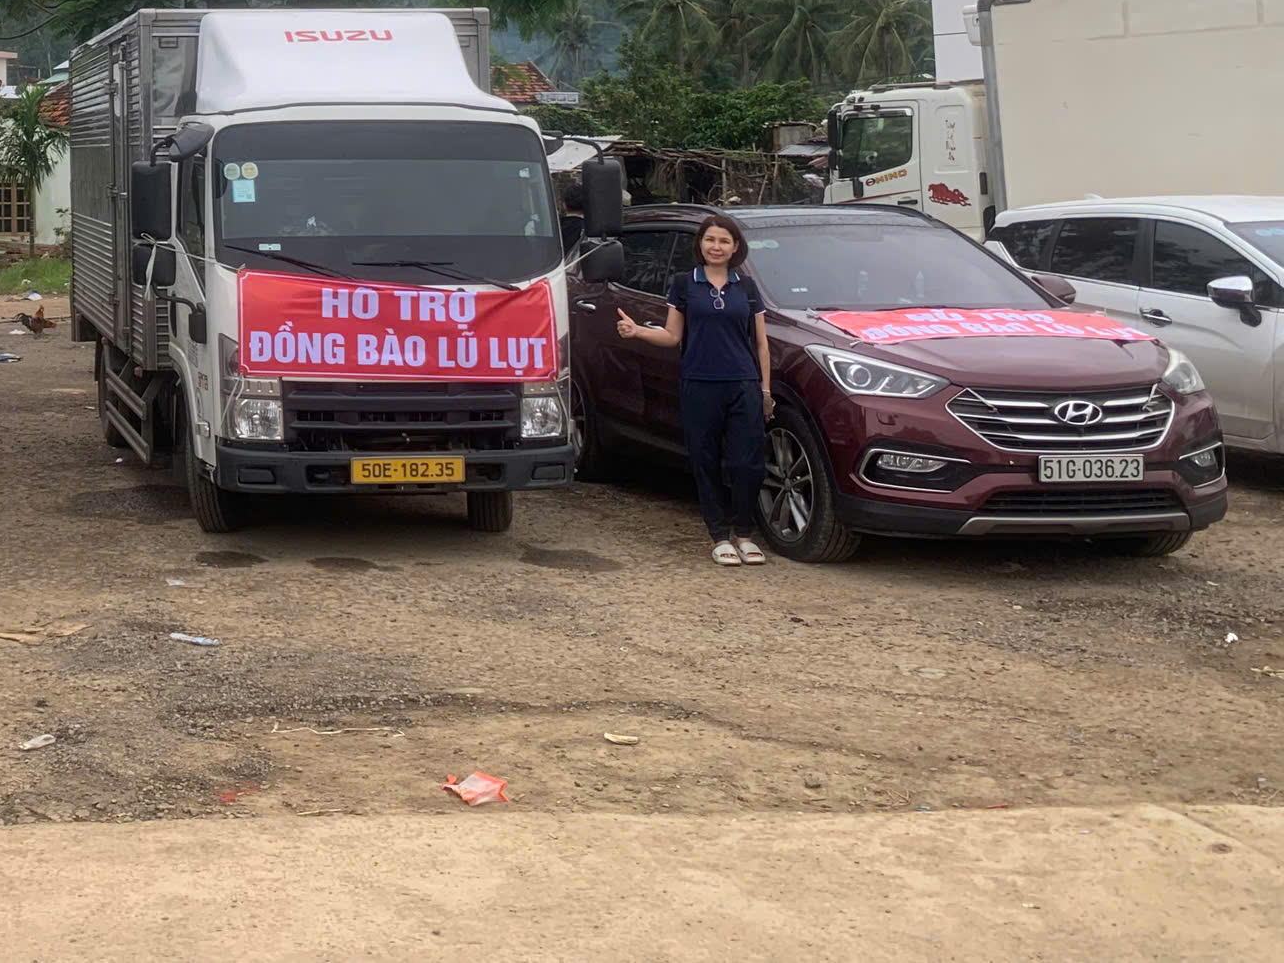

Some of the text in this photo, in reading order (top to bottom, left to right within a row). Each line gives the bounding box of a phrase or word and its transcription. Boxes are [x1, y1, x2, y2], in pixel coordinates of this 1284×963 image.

[284, 30, 394, 43] ISUZU
[393, 290, 478, 330] TRỢ
[249, 321, 547, 376] ĐỒNG BÀO LŨ LỤT
[361, 462, 455, 478] 50E-182.35
[1043, 458, 1141, 479] 51G-036.23
